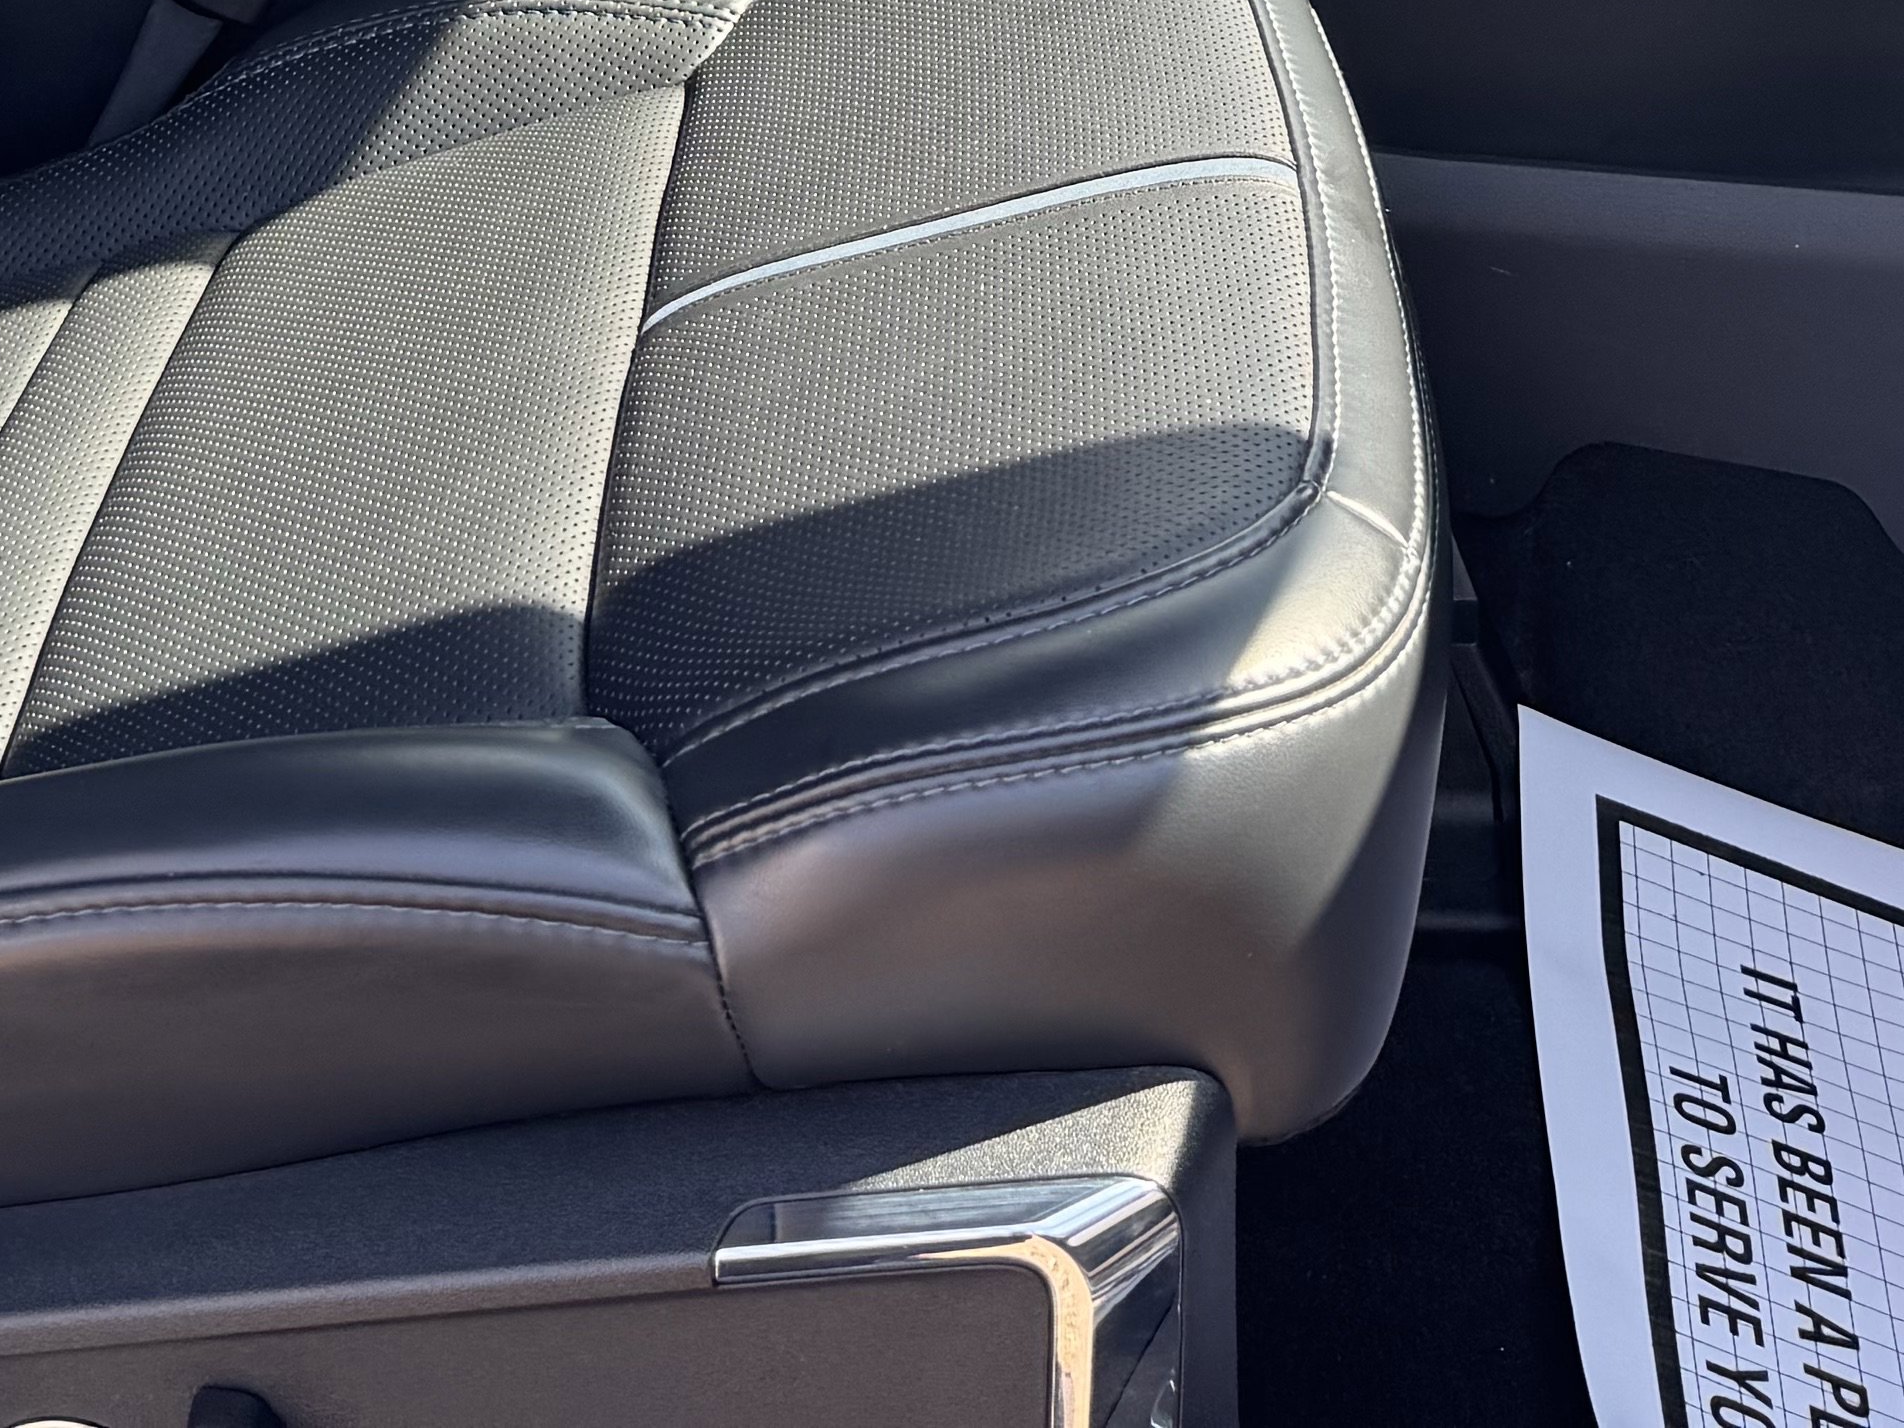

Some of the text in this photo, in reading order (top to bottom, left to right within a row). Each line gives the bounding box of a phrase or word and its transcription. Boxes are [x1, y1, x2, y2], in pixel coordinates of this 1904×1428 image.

[1739, 964, 1804, 1024] IT
[1668, 1065, 1737, 1136] TO
[1749, 1022, 1826, 1135] HAS
[1680, 1144, 1766, 1348] SERVE
[1771, 1139, 1853, 1302] BEEN
[1793, 1299, 1860, 1351] A
